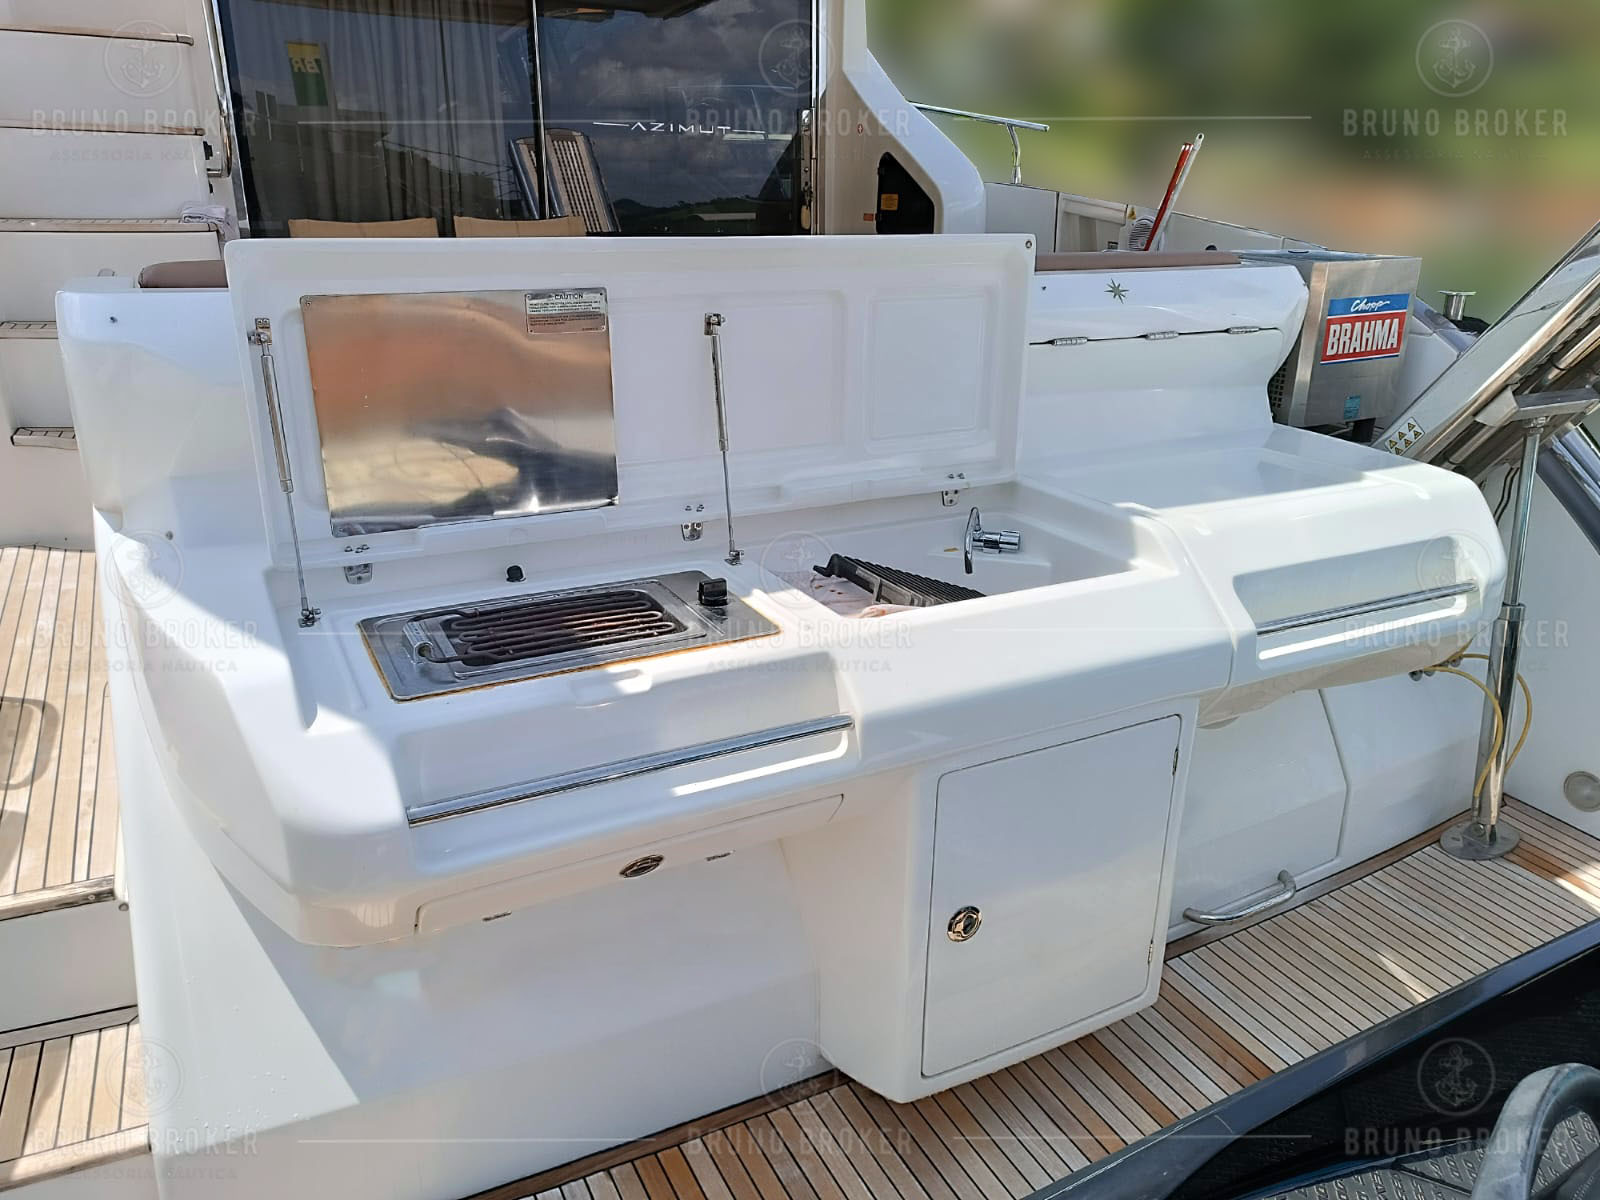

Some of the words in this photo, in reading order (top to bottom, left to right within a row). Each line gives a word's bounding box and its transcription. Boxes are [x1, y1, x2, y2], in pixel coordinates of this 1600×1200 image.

[631, 121, 731, 135] AZIMUT
[554, 292, 584, 300] CAUTION
[1350, 299, 1391, 312] Chopp
[1326, 318, 1399, 356] BRAHMA
